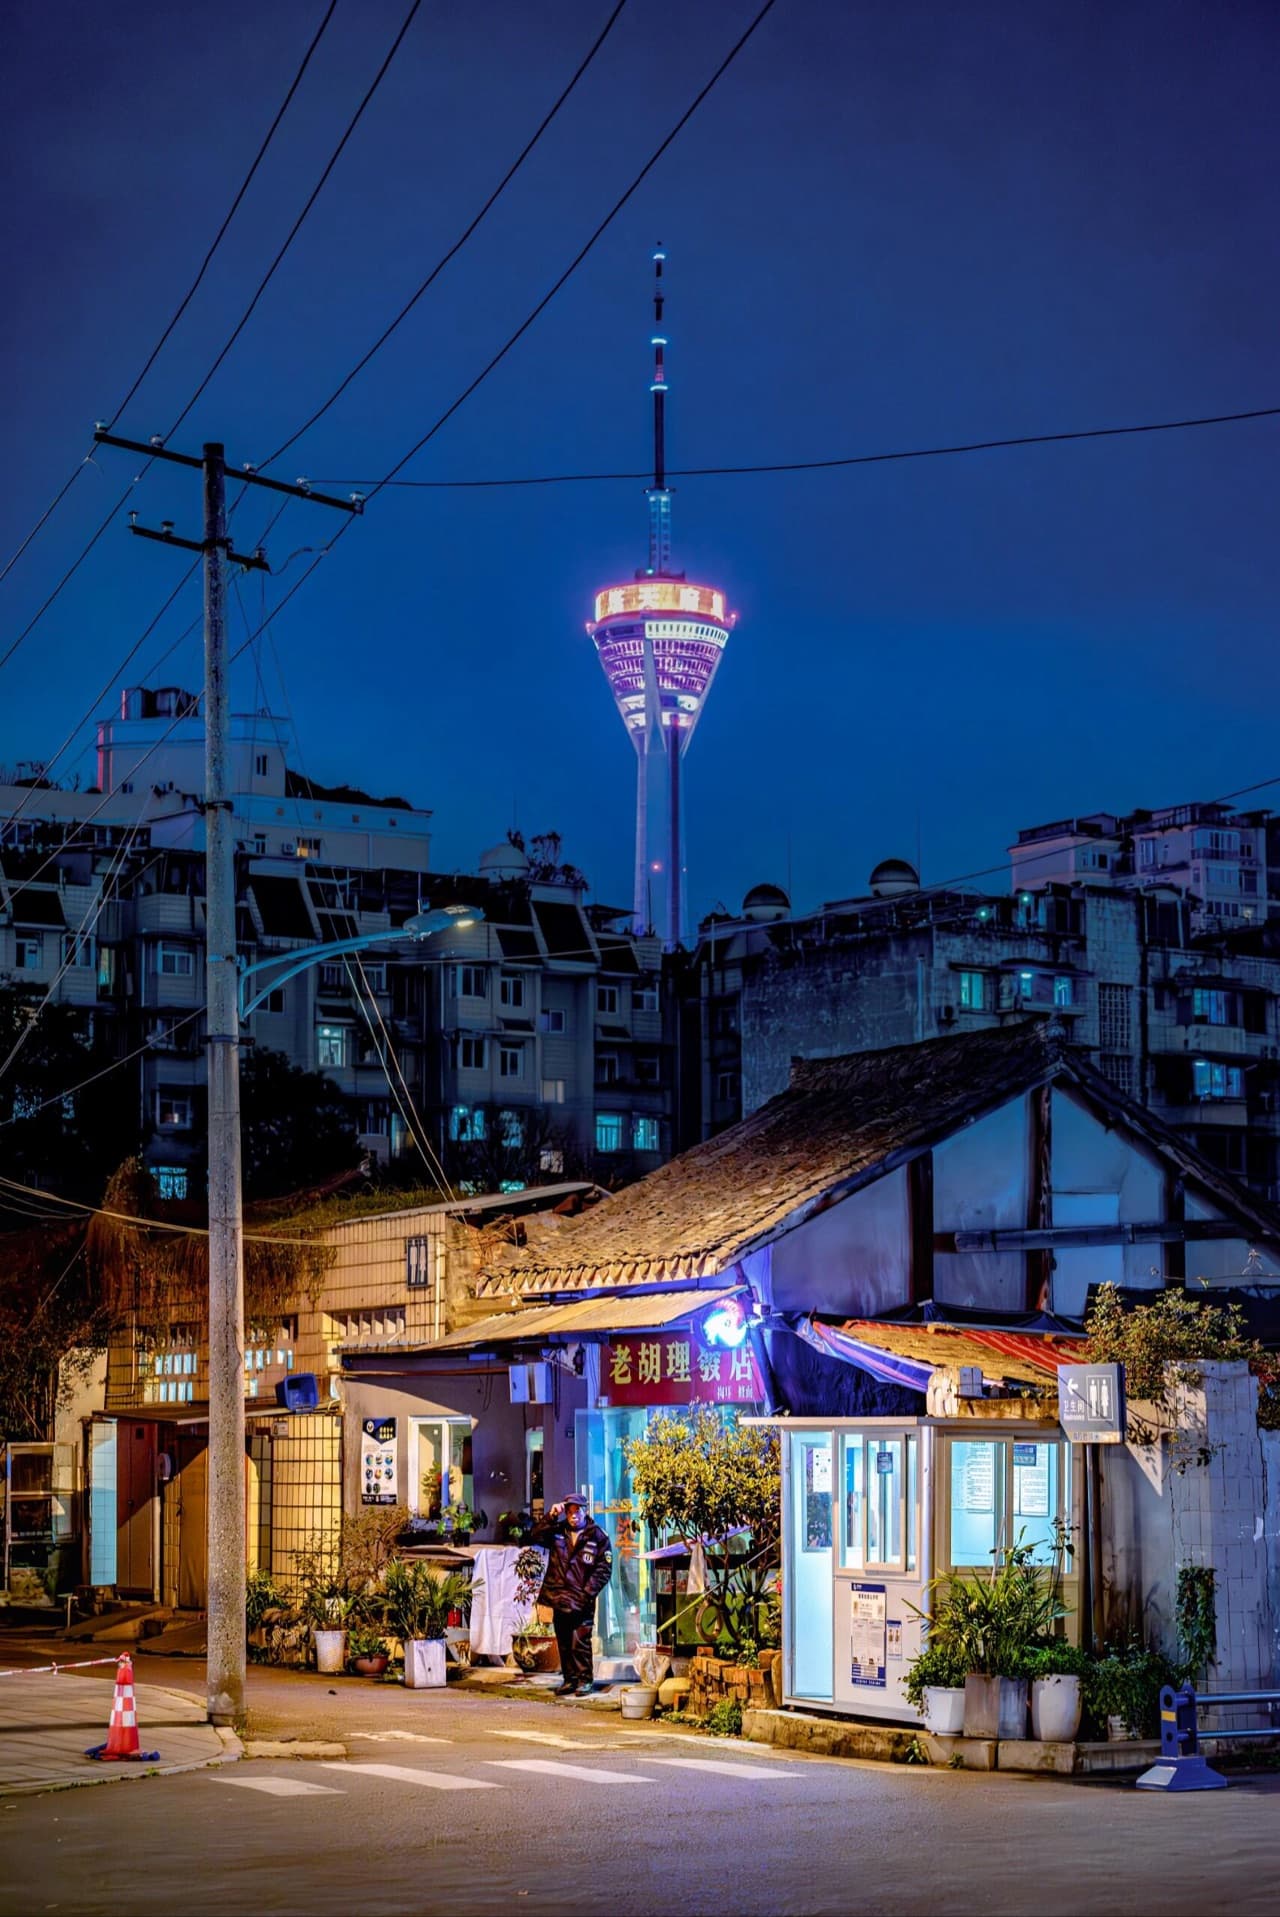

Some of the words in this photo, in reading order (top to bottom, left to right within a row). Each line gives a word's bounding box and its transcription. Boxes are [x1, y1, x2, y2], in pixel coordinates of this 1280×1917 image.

[609, 1340, 755, 1385] 老胡理發店
